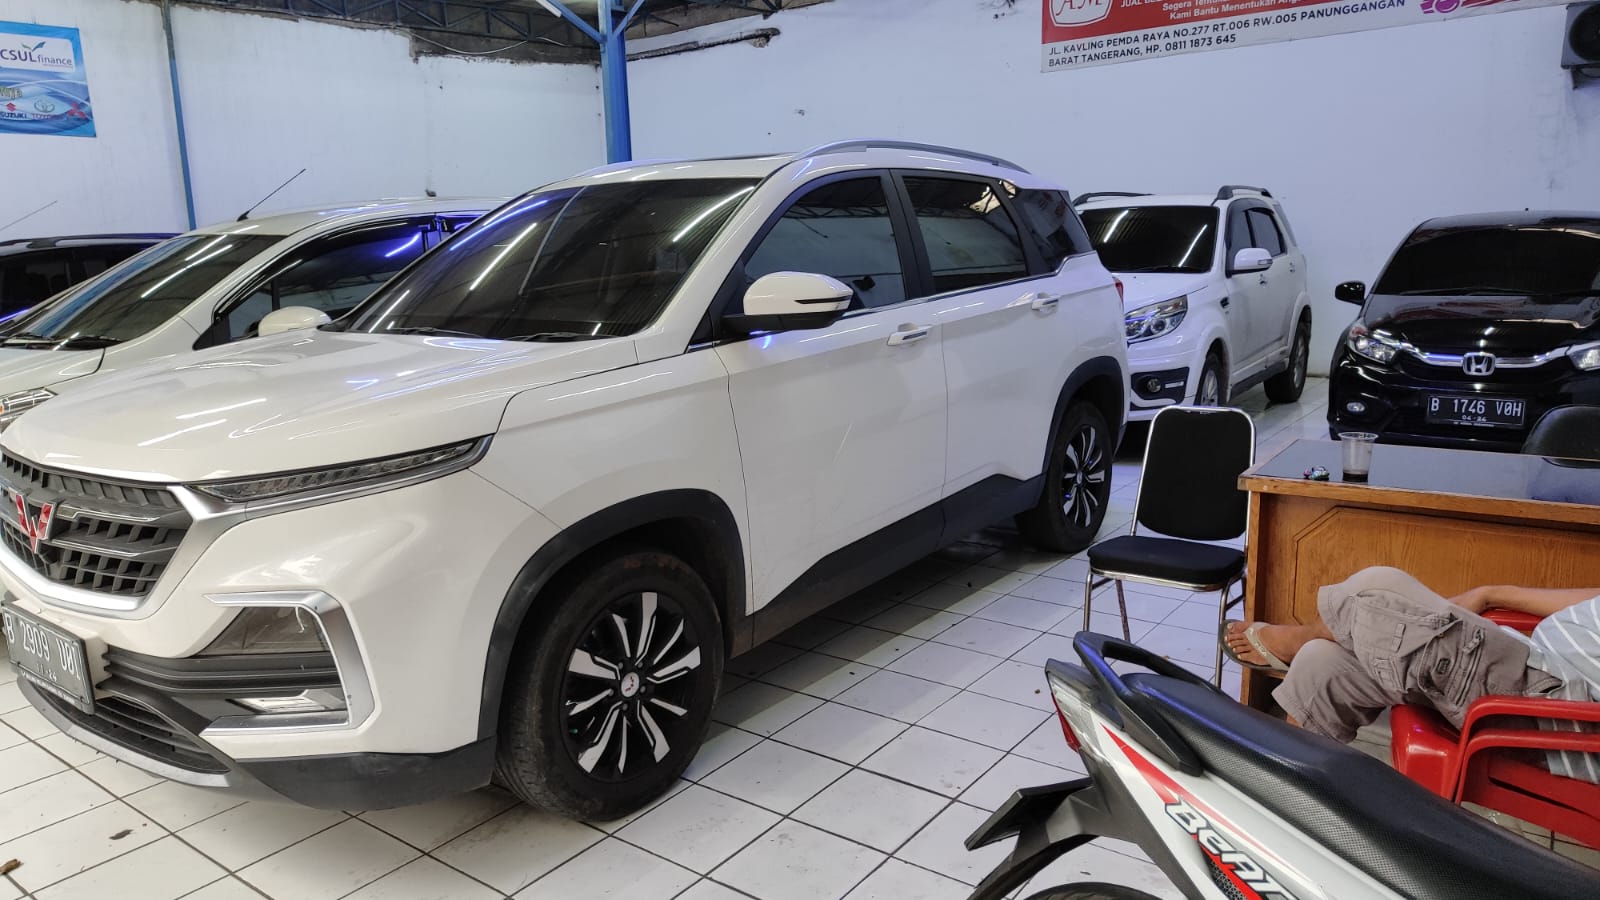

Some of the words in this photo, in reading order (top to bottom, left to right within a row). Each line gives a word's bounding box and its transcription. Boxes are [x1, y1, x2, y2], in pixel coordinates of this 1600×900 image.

[1163, 1, 1192, 11] Segera
[1170, 9, 1191, 20] Kami
[1193, 6, 1219, 17] Bantu
[1221, 0, 1276, 12] Menentukan
[1049, 47, 1061, 56] JL.
[1063, 41, 1104, 54] KAVLING
[1106, 36, 1140, 47] PEMDA
[1143, 31, 1170, 42] RAYA
[1173, 26, 1210, 38] NO.277
[1212, 20, 1250, 33] RT.006
[1253, 13, 1297, 27] RW.005
[1300, 0, 1405, 21] PANUNGGANGAN
[1048, 56, 1078, 67] BARAT
[1082, 48, 1143, 61] TANGERANG,
[1146, 44, 1162, 54] HP.
[1165, 41, 1187, 51] 0811
[1190, 37, 1213, 48] 1873
[1216, 34, 1236, 45] 645
[1431, 397, 1440, 412] B
[1453, 399, 1486, 414] 1746
[4, 612, 15, 644] B
[20, 620, 50, 662] 2909
